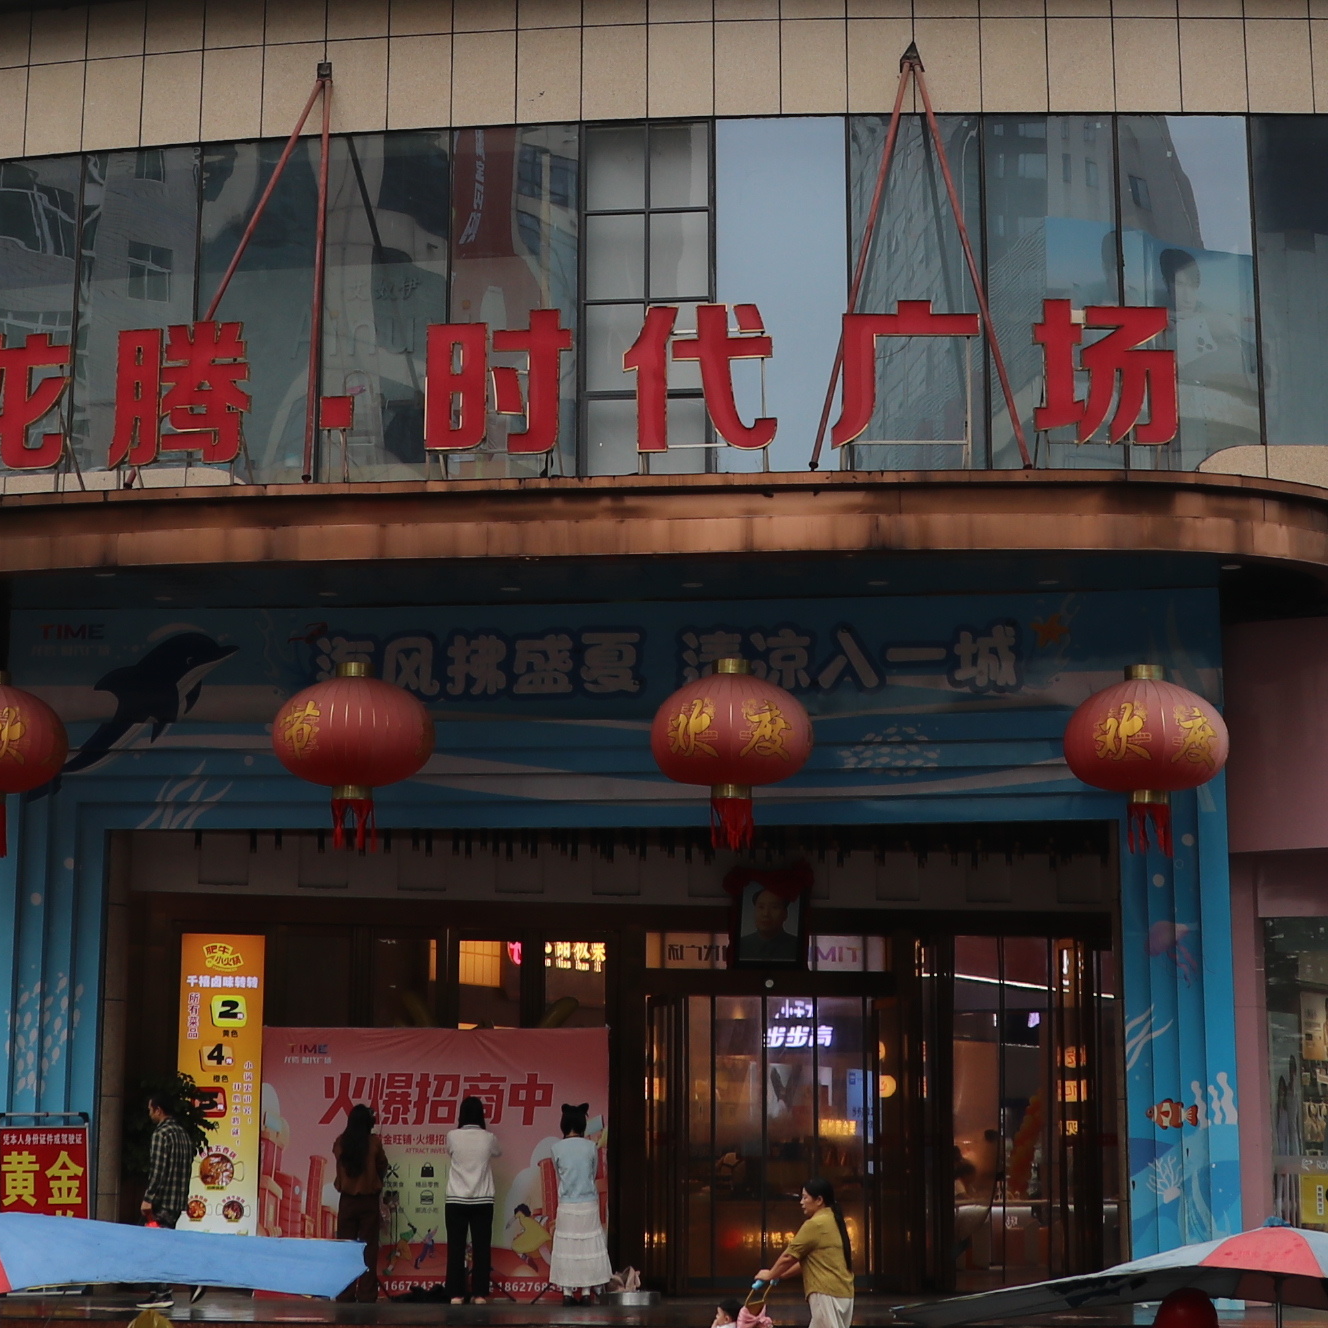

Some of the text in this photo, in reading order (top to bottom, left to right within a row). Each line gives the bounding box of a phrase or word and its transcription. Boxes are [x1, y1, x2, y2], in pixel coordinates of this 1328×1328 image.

[36, 623, 106, 641] TIME
[206, 944, 230, 956] 肥牛
[187, 992, 200, 1039] 所有菜品
[763, 1025, 833, 1049] 步步高
[288, 1042, 329, 1055] TIME
[0, 1150, 85, 1207] 黄金
